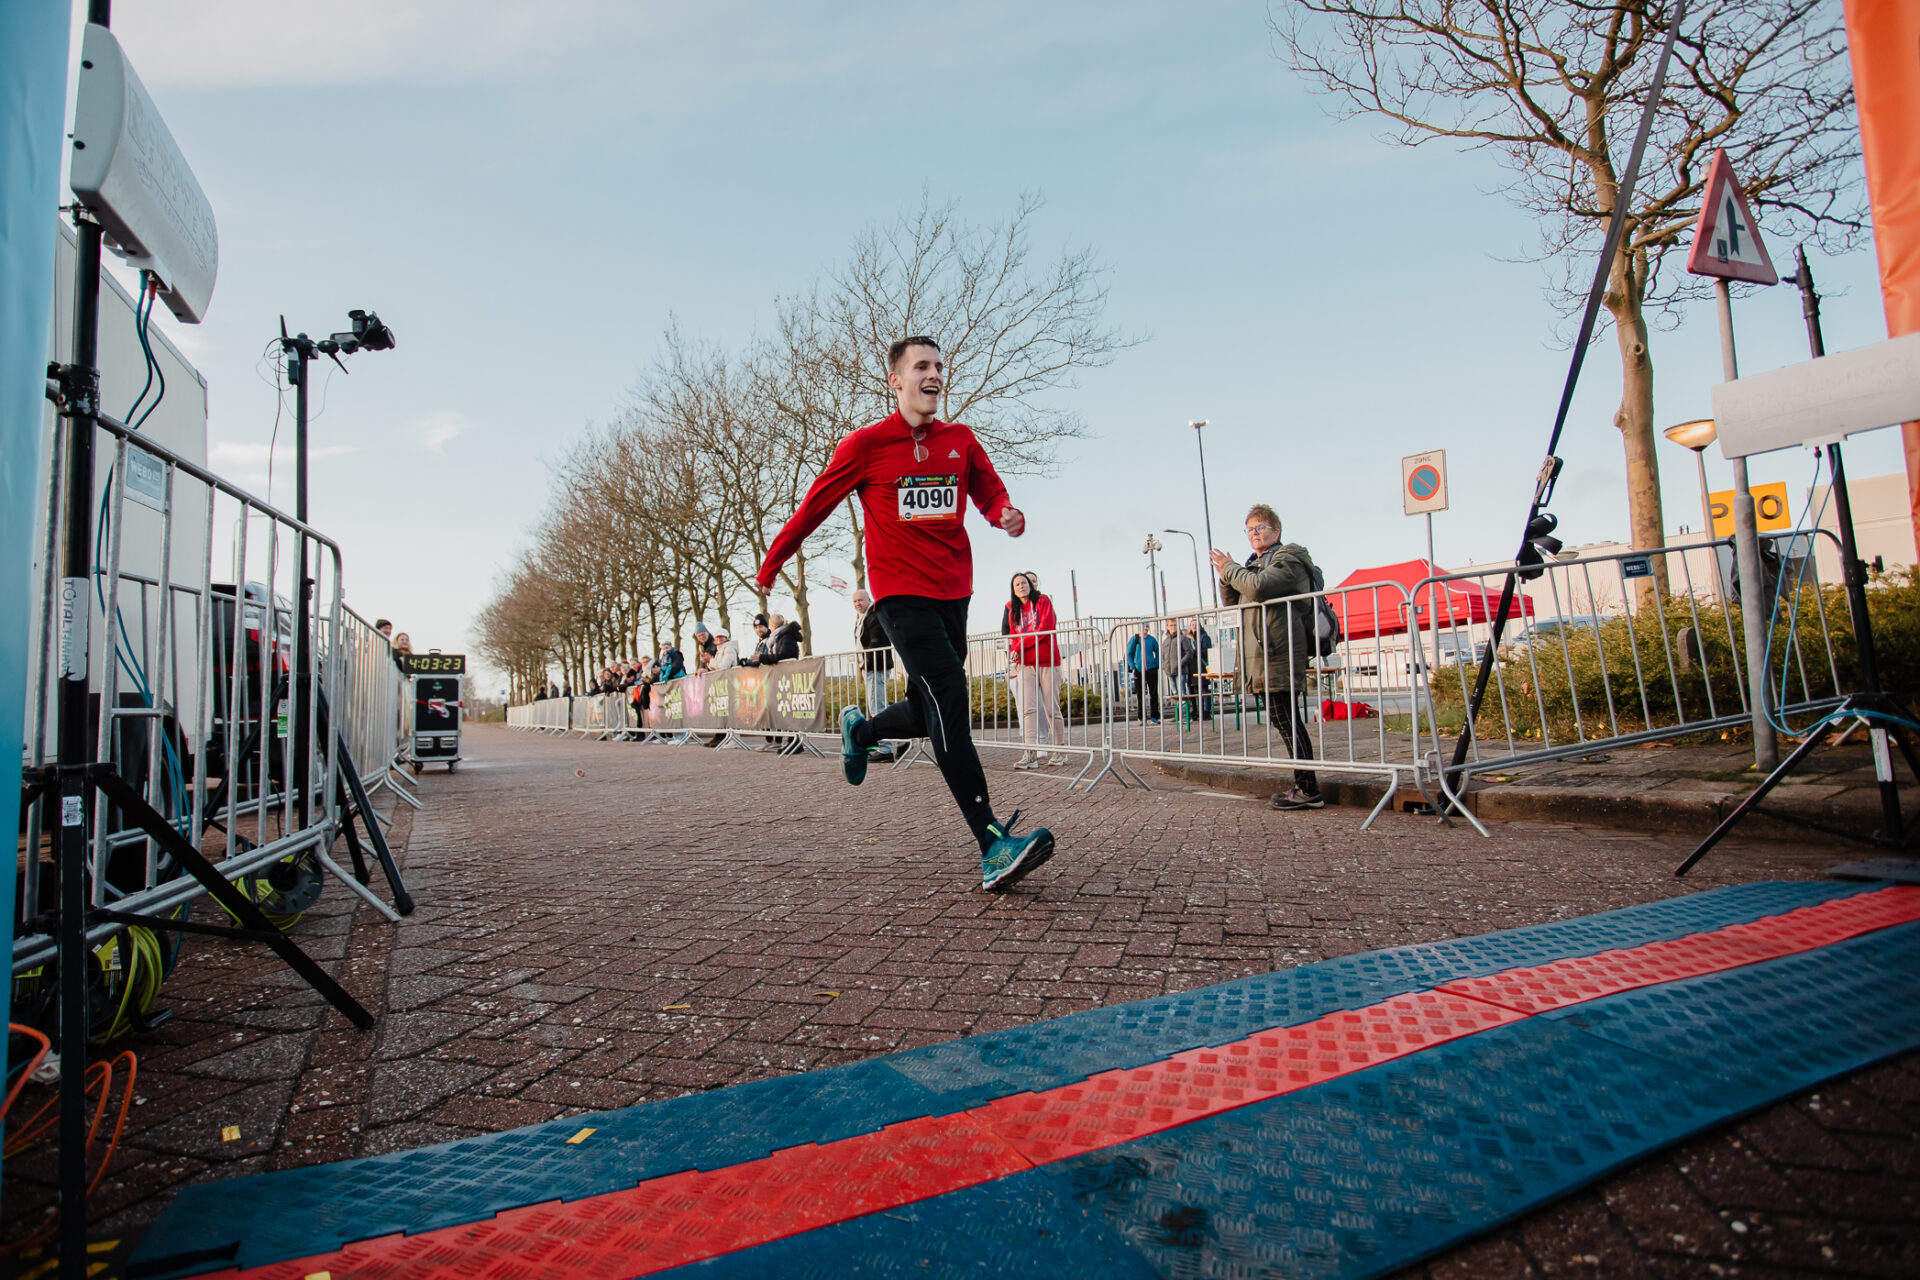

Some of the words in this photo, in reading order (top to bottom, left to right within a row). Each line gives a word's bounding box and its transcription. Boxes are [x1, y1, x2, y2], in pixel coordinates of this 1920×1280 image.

[1414, 455, 1431, 464] ZONE
[902, 488, 954, 509] 4090
[409, 658, 462, 670] 4:03:23
[791, 672, 816, 693] VALK
[791, 693, 816, 711] EVENT
